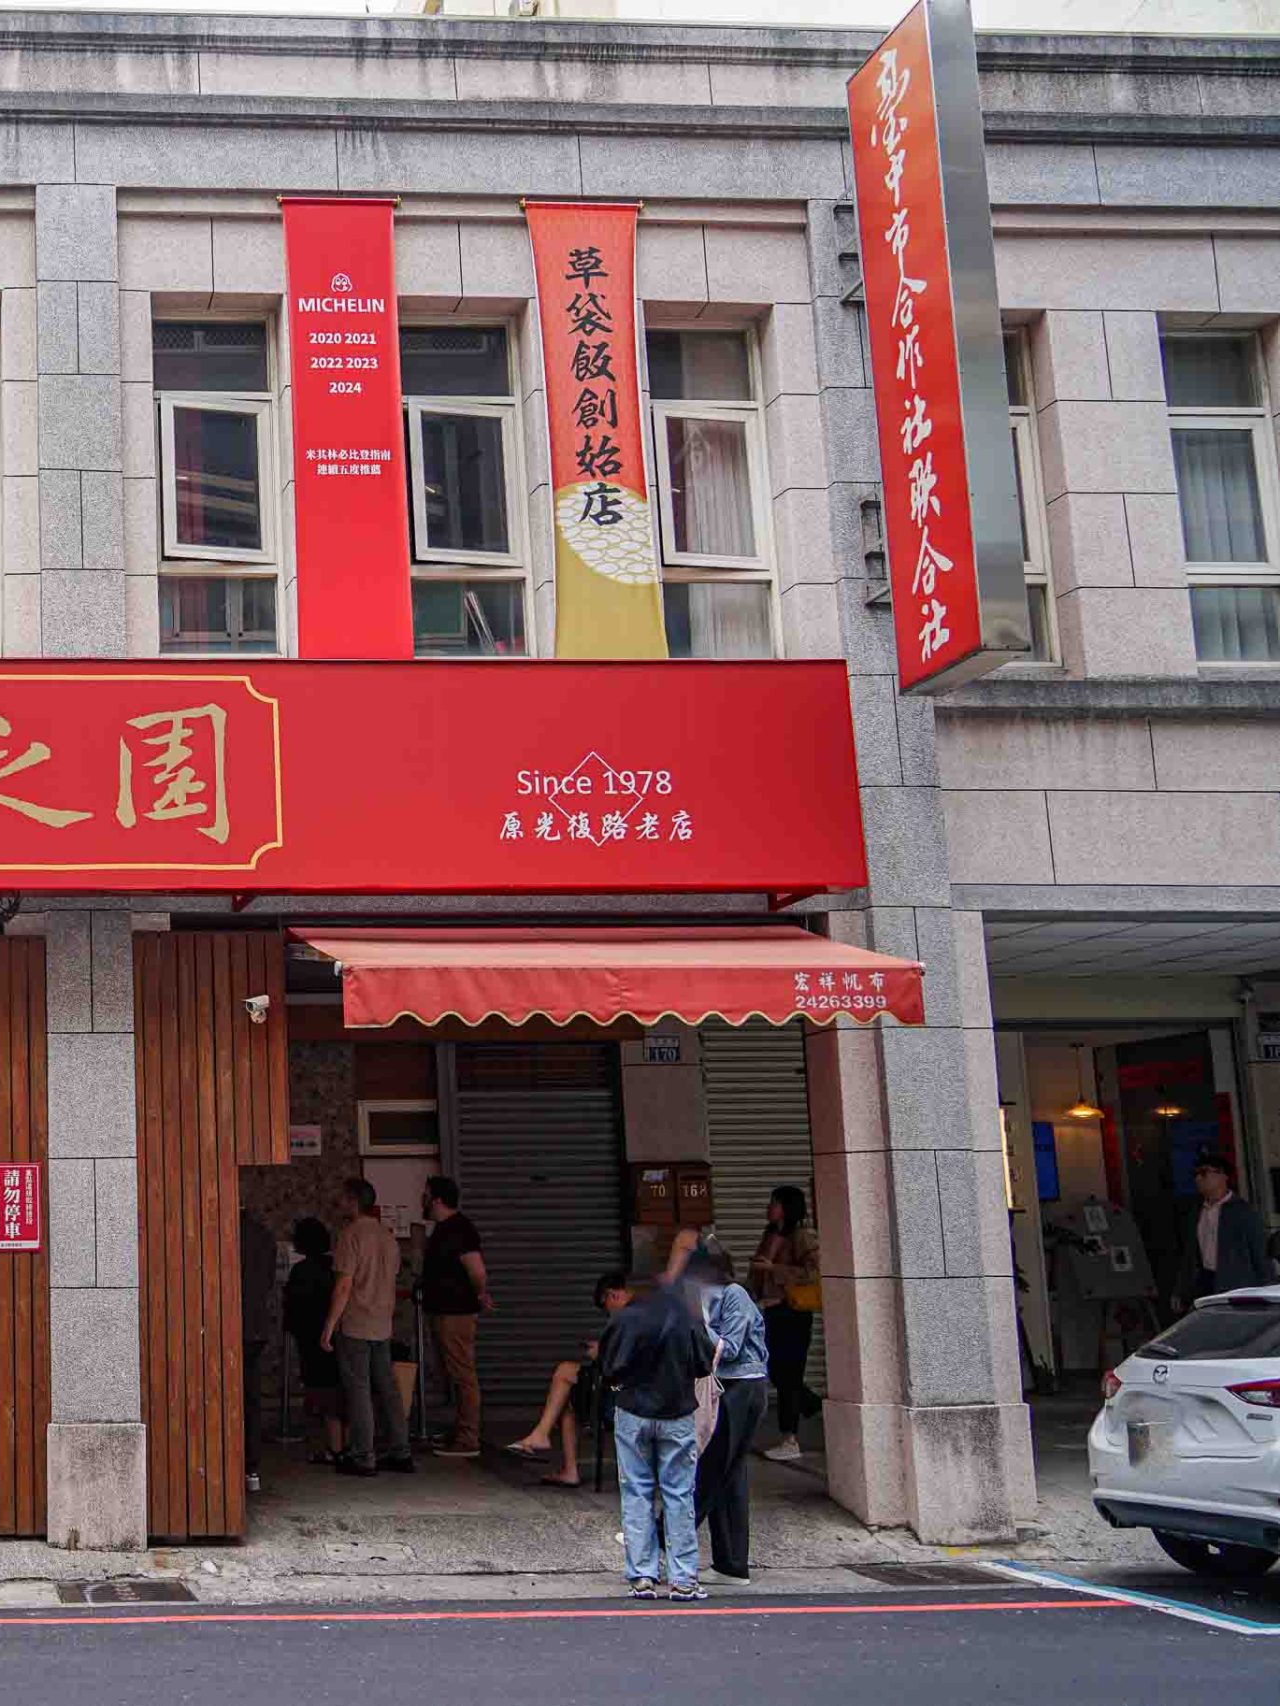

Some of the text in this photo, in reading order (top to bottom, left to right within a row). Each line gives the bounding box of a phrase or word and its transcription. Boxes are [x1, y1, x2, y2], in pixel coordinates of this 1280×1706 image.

[298, 298, 385, 313] MICHELIN
[309, 332, 377, 345] 2020 2021
[310, 357, 378, 369] 2022 2023
[328, 381, 362, 394] 2024
[565, 247, 624, 527] 草袋飯創始店
[306, 449, 391, 461] 米其林必比登指南
[517, 770, 673, 795] Since 1978
[498, 809, 695, 841] 原光復路老店
[794, 971, 886, 992] 宏祥帆布
[795, 995, 887, 1009] 24263399
[3, 1169, 21, 1239] 請勿停車
